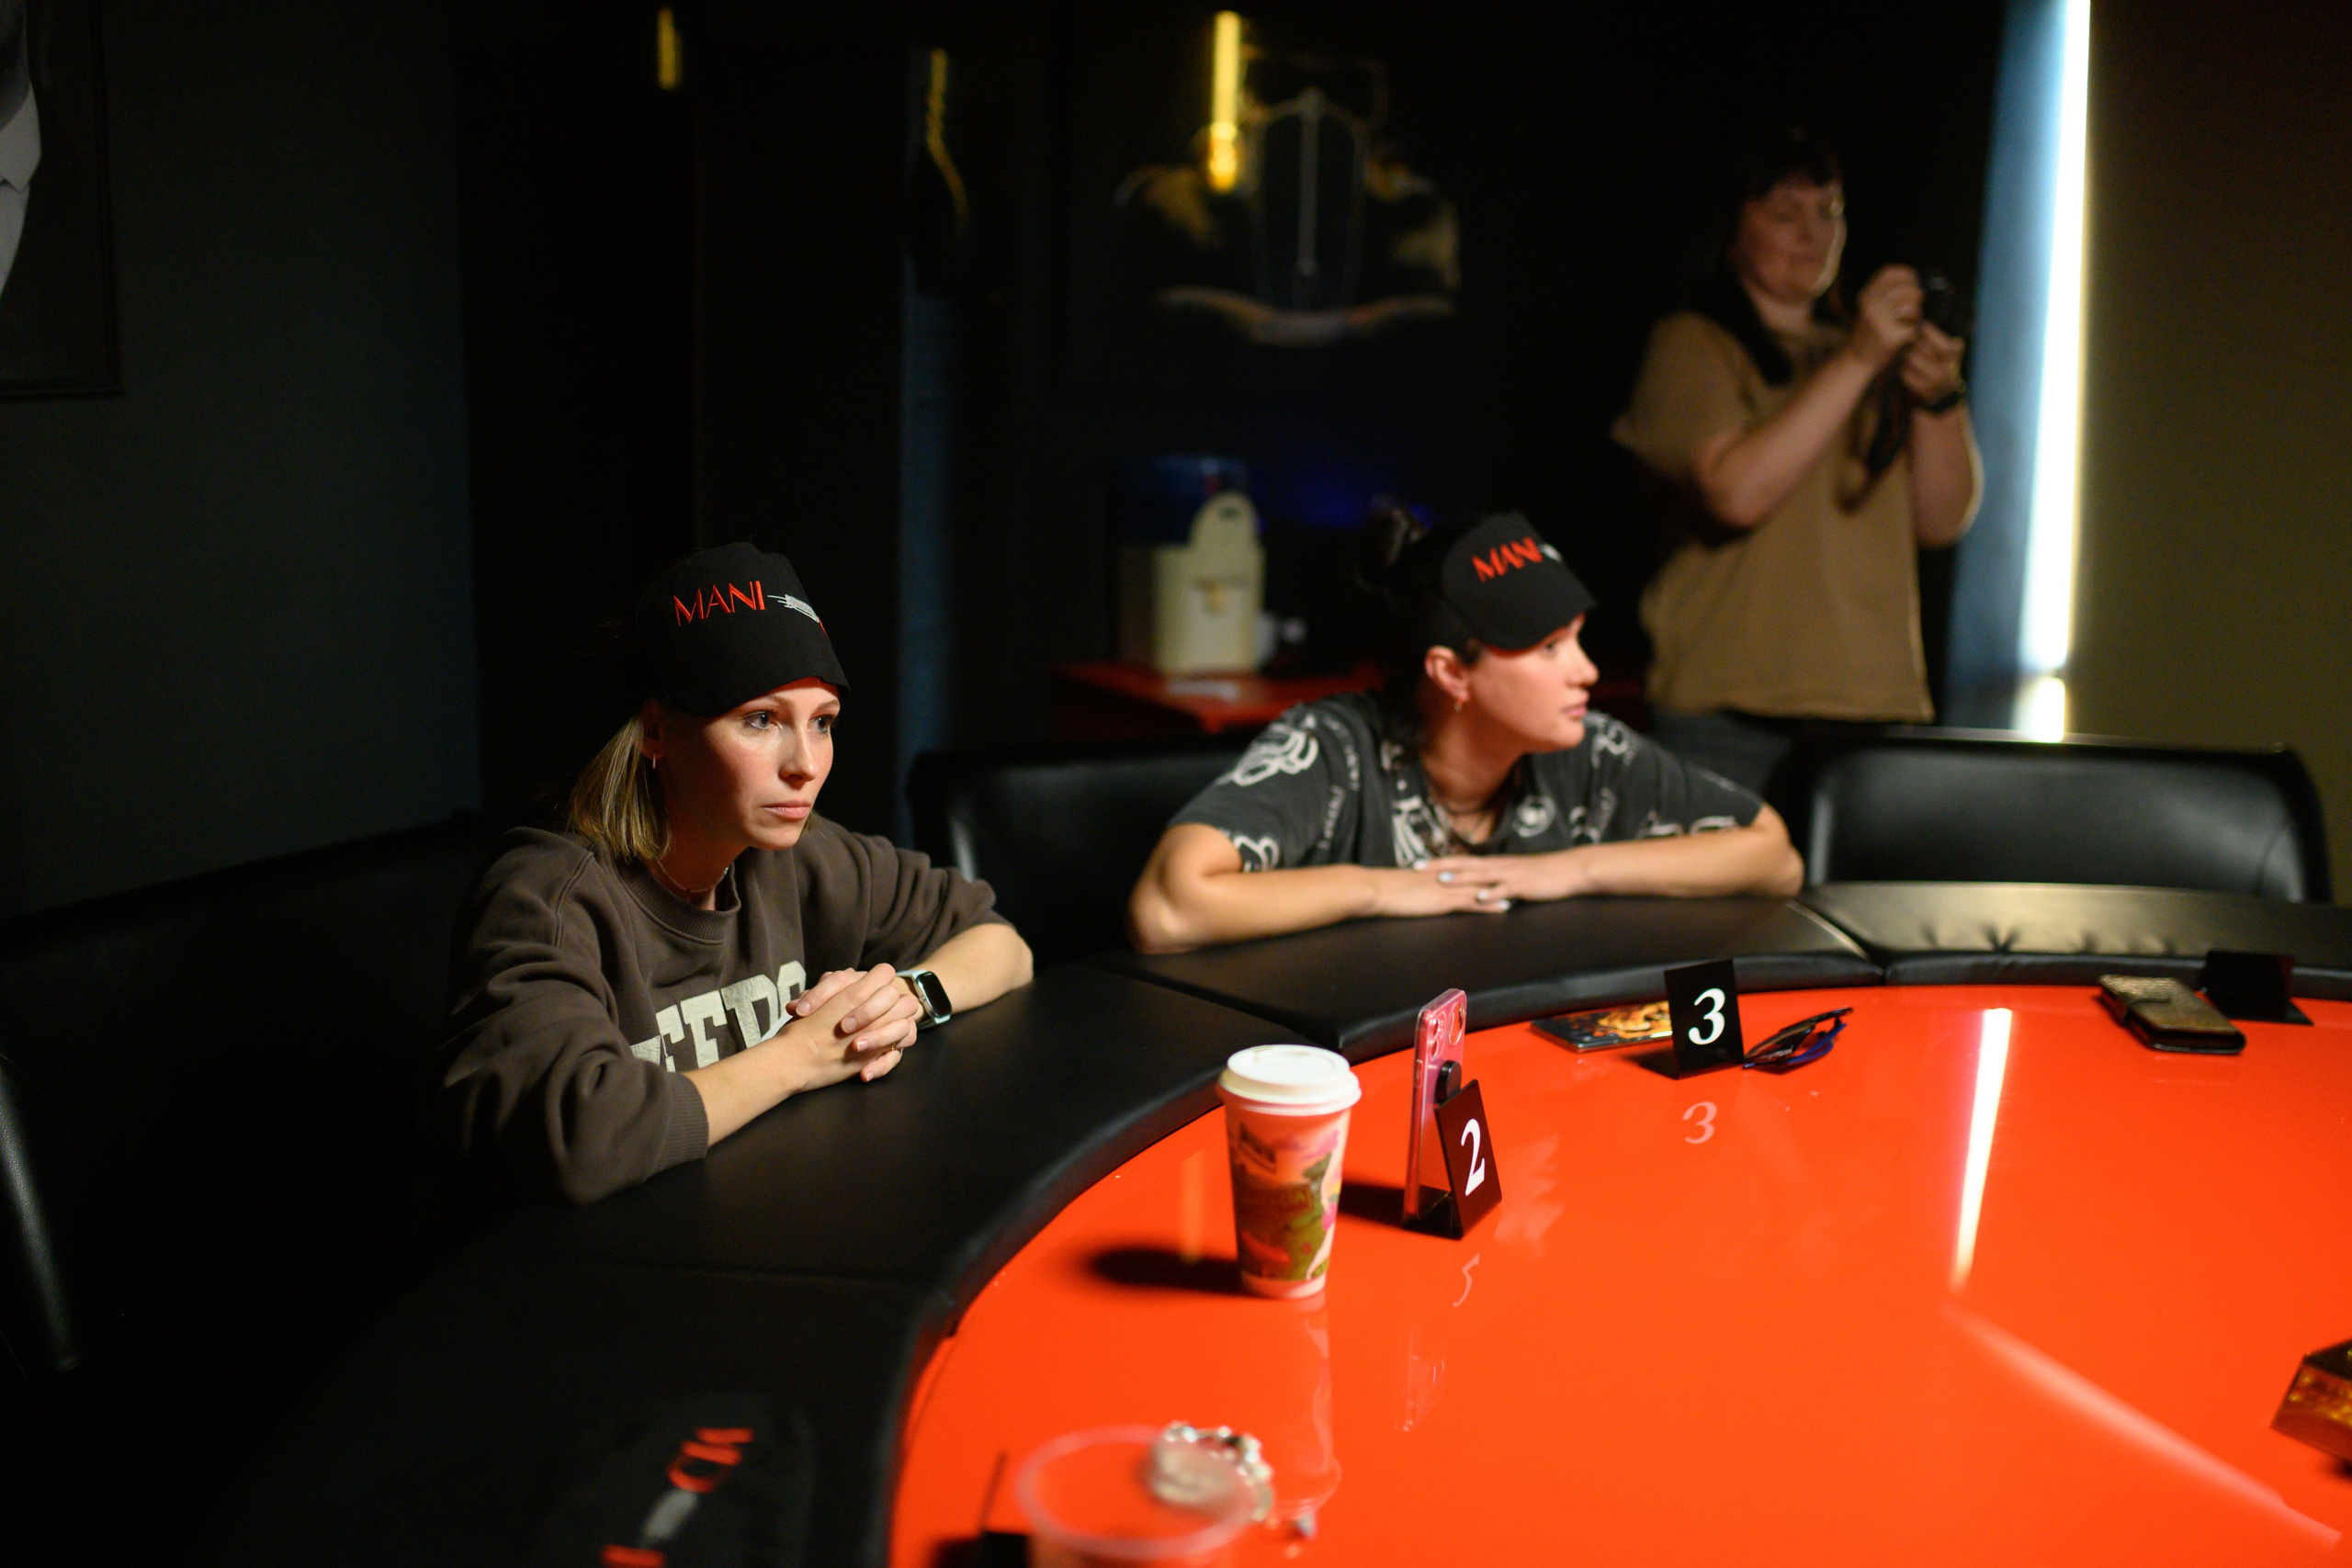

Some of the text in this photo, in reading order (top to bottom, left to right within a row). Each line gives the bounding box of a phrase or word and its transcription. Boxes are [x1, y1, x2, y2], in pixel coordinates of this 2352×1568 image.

[673, 581, 765, 625] MANI
[1689, 988, 1724, 1044] 3
[1461, 1119, 1485, 1196] 2
